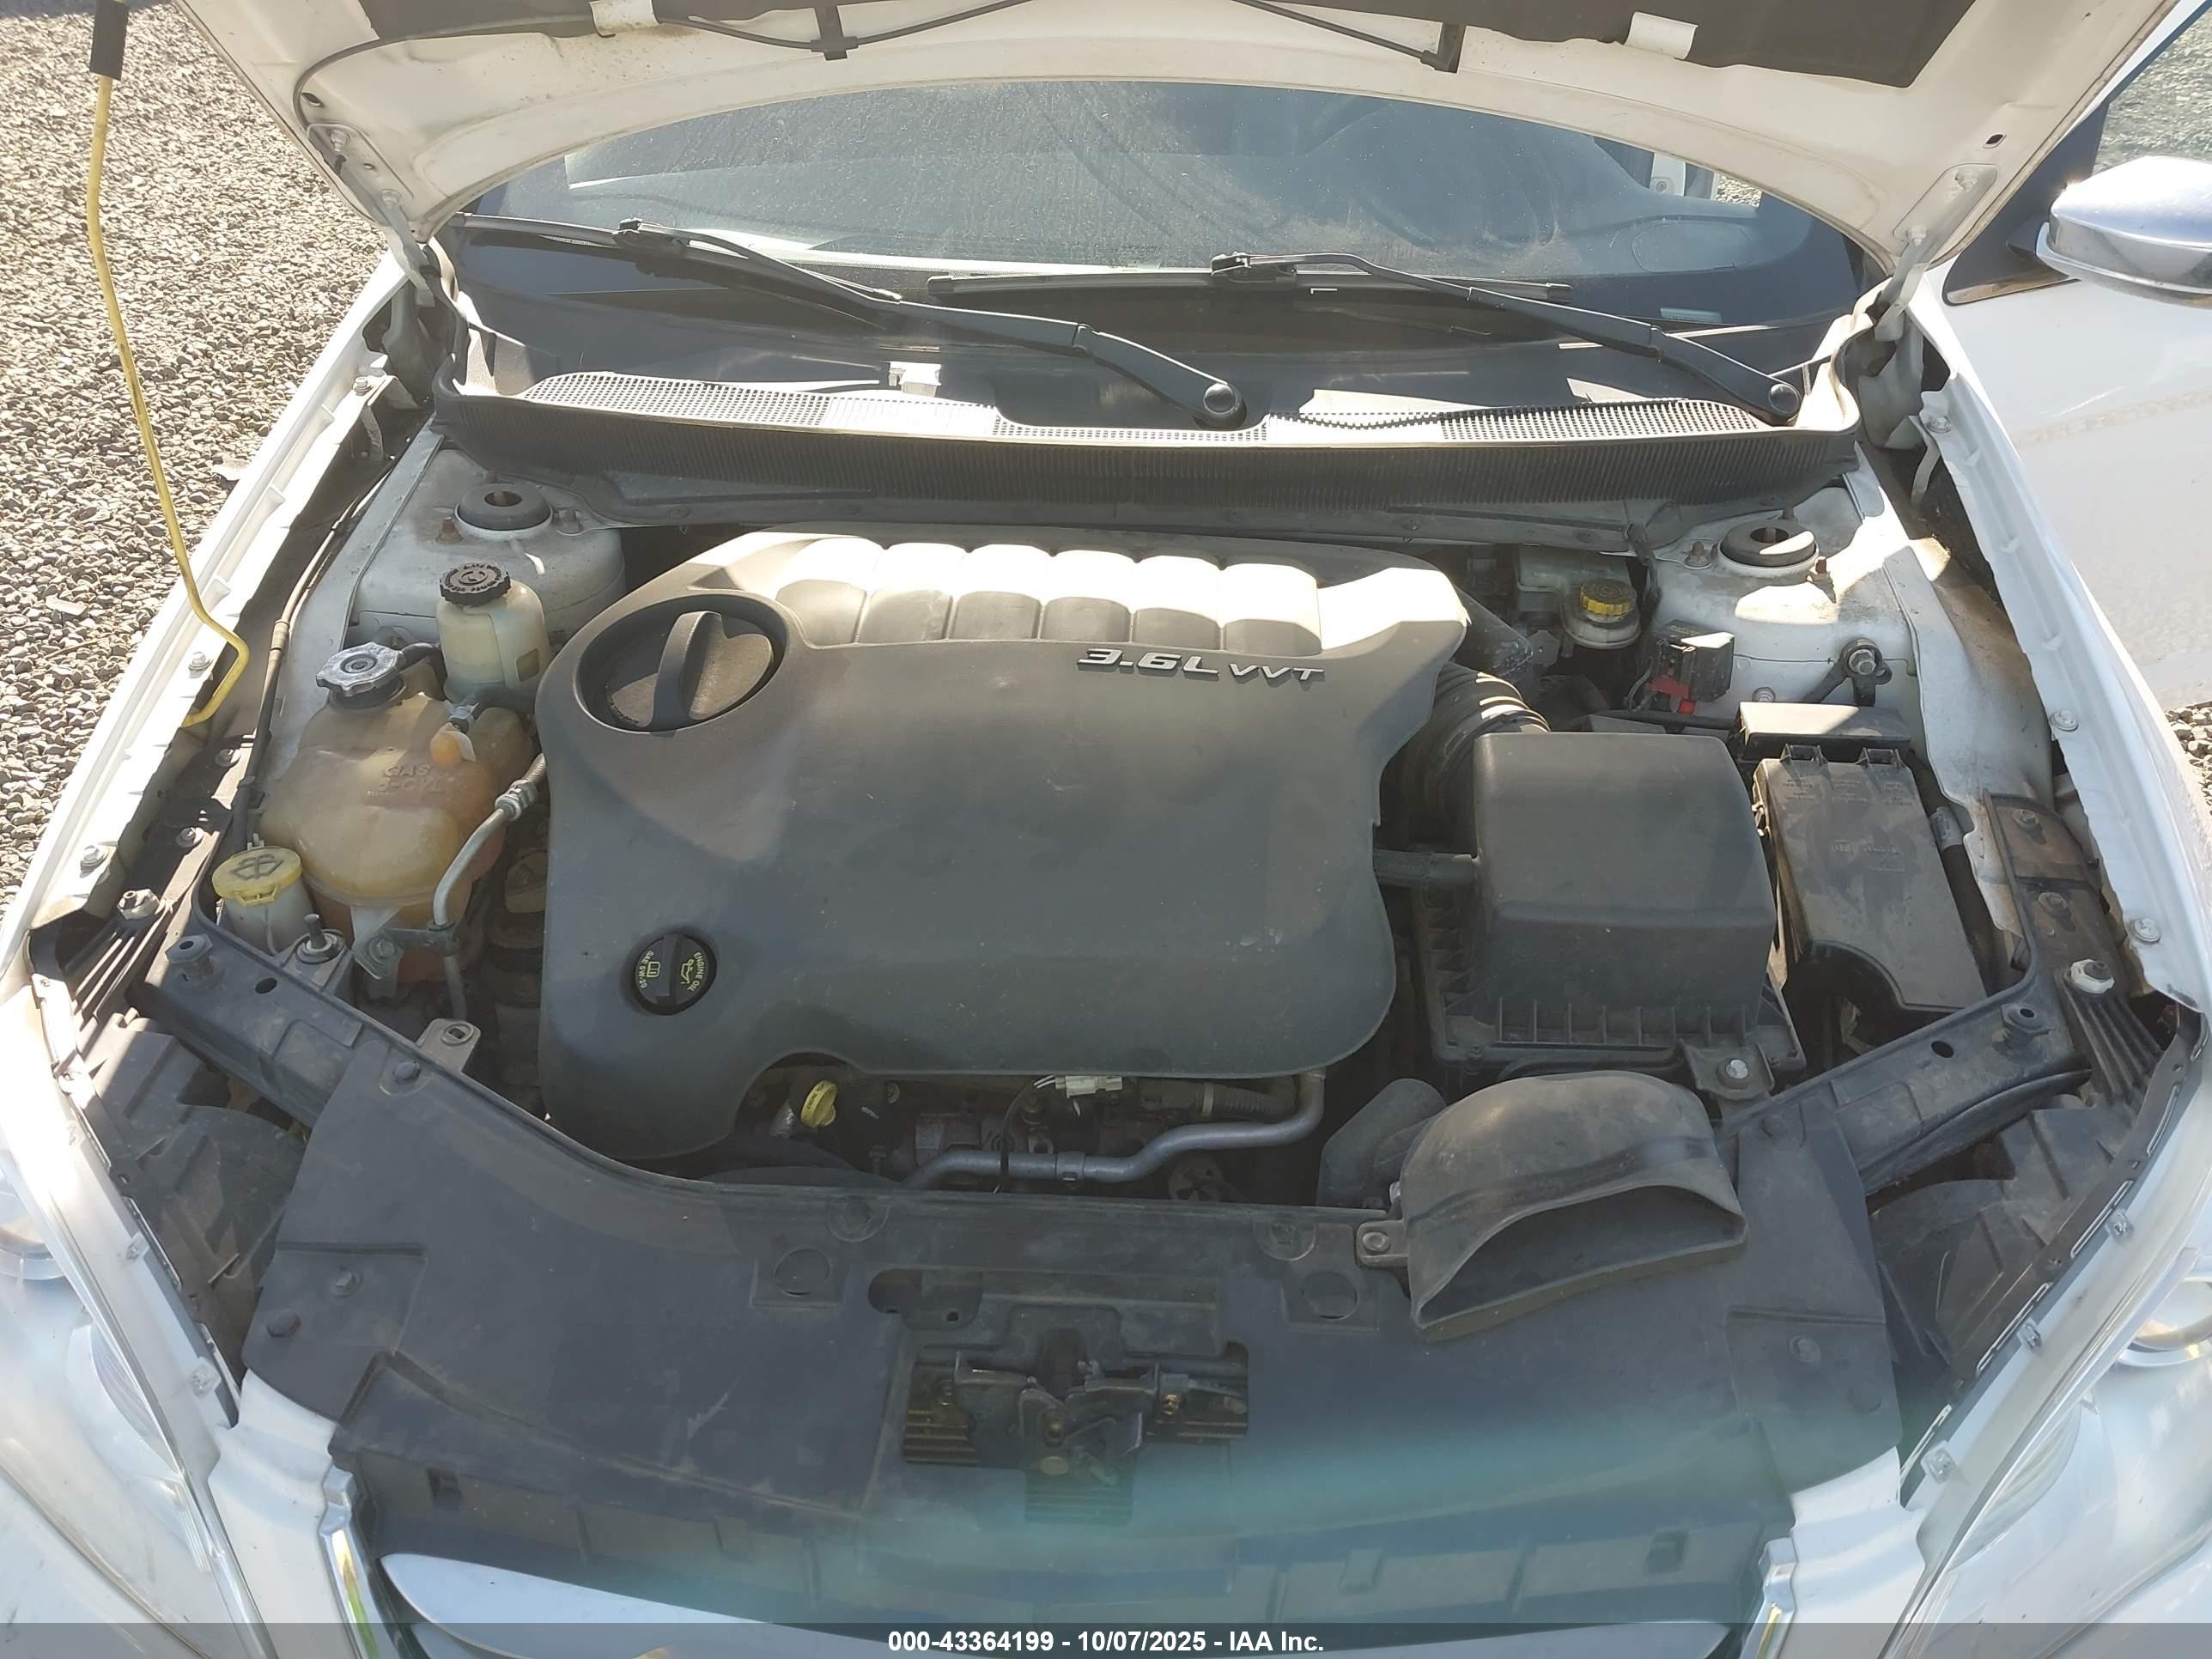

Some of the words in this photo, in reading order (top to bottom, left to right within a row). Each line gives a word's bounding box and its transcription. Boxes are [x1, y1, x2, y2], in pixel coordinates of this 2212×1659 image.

[1077, 648, 1219, 676] 3.6L
[1228, 663, 1326, 680] VVT
[641, 950, 654, 964] SAE
[693, 951, 705, 980] ENGINE
[687, 980, 700, 991] OIL
